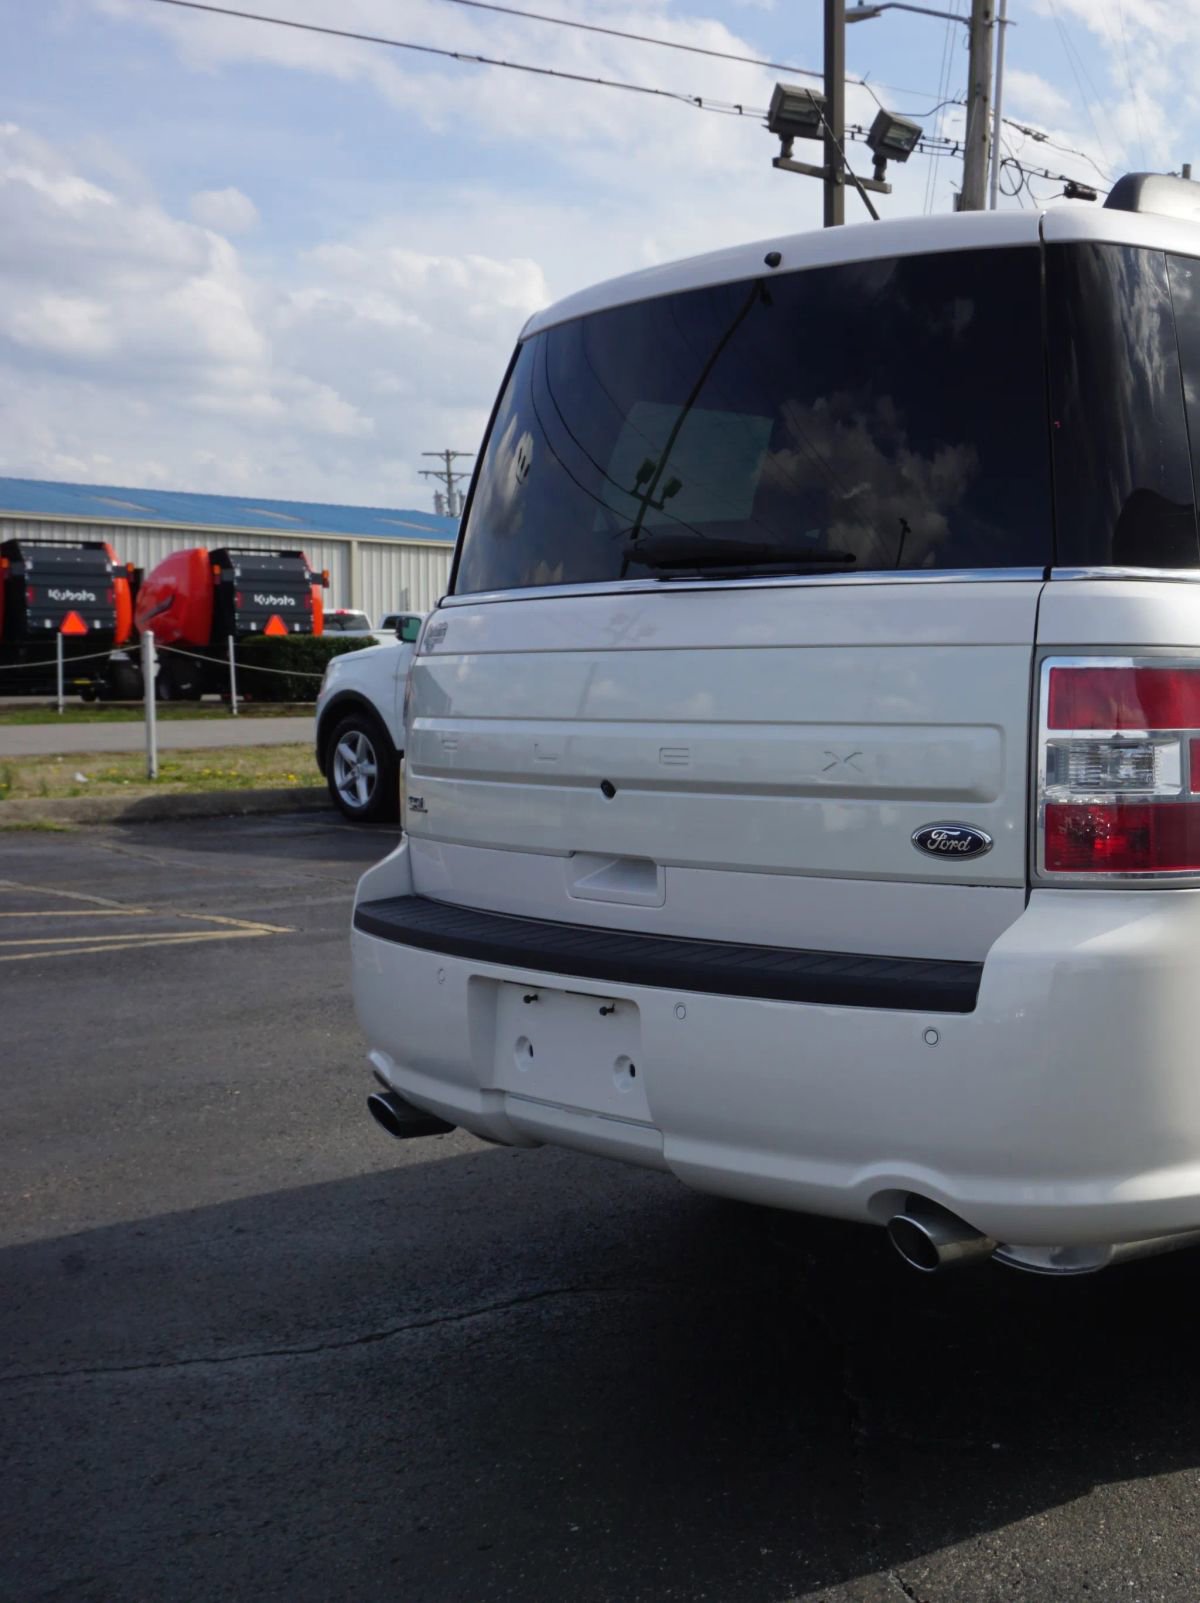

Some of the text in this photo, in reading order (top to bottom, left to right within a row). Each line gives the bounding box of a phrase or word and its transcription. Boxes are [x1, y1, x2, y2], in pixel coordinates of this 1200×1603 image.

[48, 588, 96, 601] Kubota
[253, 594, 296, 606] Kubota
[927, 829, 973, 851] Ford
